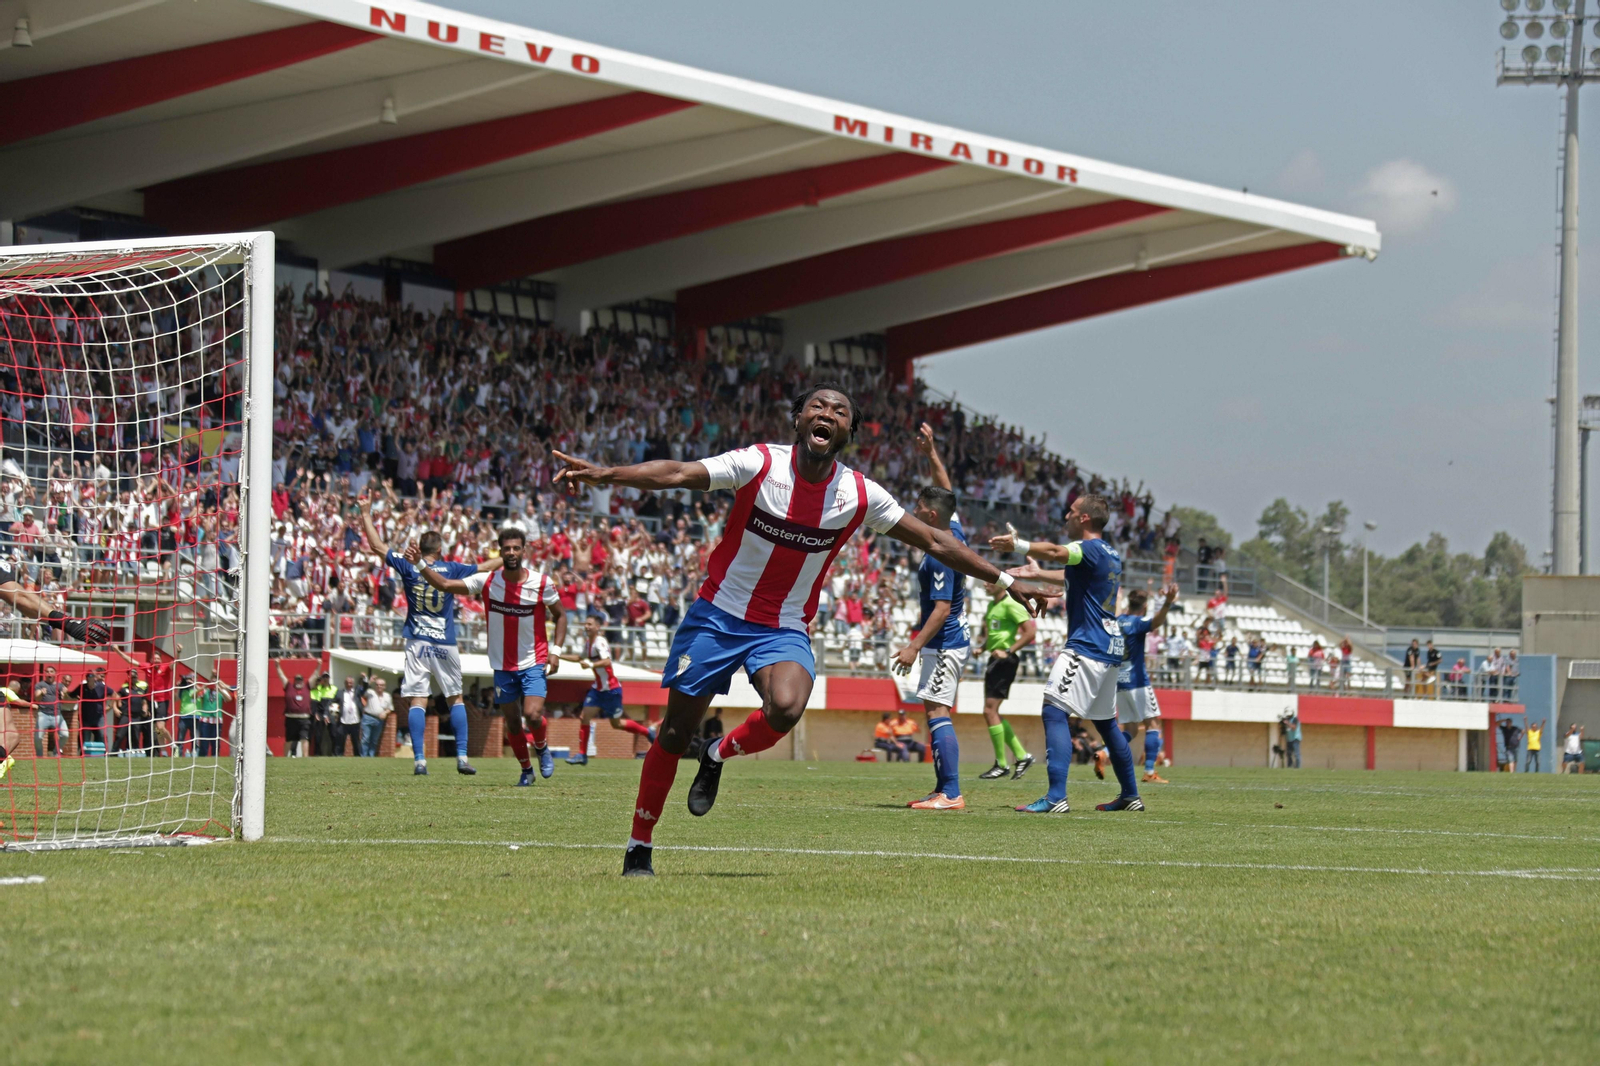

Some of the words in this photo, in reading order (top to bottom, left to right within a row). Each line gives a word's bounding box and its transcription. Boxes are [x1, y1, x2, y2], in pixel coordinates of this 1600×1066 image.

[370, 6, 600, 74] NUEVO
[833, 114, 1078, 183] MIRADOR
[767, 476, 791, 491] Kappa
[412, 584, 445, 613] 10
